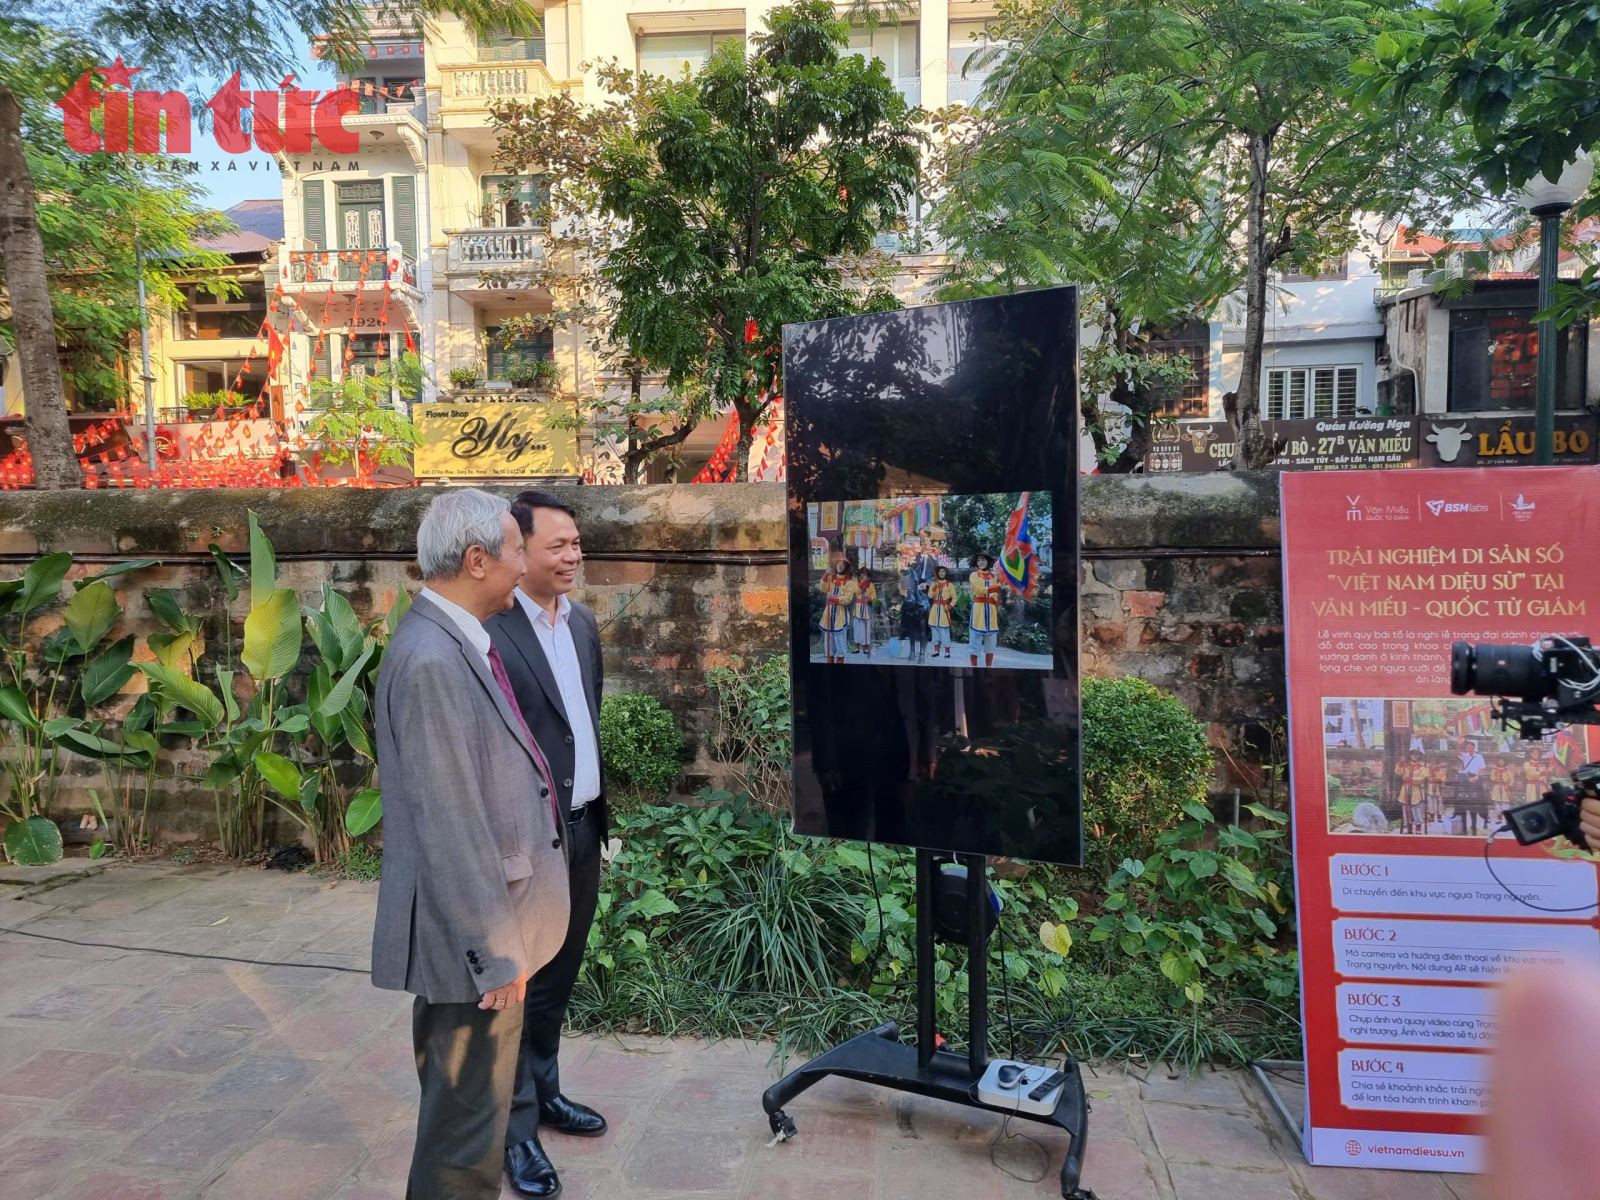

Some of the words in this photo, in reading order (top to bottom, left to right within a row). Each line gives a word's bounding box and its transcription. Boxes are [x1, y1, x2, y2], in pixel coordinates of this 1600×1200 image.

[426, 410, 449, 419] Flower
[450, 410, 469, 420] Shop
[1316, 421, 1346, 432] Quán
[1386, 419, 1411, 431] Nga
[1210, 443, 1236, 458] CHU
[1291, 436, 1309, 456] BÒ
[1347, 434, 1377, 454] VĂN
[1379, 430, 1412, 453] MIẾU
[1478, 419, 1537, 456] LẨU
[1326, 545, 1372, 568] TRẢI
[1378, 545, 1457, 567] NGHIỆM
[1462, 549, 1483, 564] DI
[1489, 543, 1531, 564] SẢN
[1535, 542, 1565, 564] SỐ
[1387, 575, 1435, 591] NAM
[1441, 572, 1487, 593] DIỆU
[1531, 573, 1565, 592] TẠI
[1311, 598, 1354, 617] VĂN
[1360, 596, 1407, 617] MIẾU
[1426, 595, 1490, 619] QUỐC
[1527, 596, 1587, 617] GIÁM
[1331, 630, 1351, 639] vinh
[1353, 632, 1371, 641] quy
[1374, 630, 1390, 639] bái
[1417, 630, 1439, 641] nghi
[1453, 631, 1480, 642] trọng
[1482, 630, 1499, 641] đại
[1501, 630, 1528, 639] dành
[1382, 642, 1409, 652] trong
[1414, 642, 1439, 650] khoa
[1352, 652, 1378, 661] danh
[1390, 652, 1410, 661] kinh
[1343, 664, 1362, 672] che
[1340, 863, 1381, 877] BƯỚC
[1384, 866, 1389, 877] 1
[1342, 886, 1352, 896] Di
[1354, 886, 1388, 898] chuyển
[1389, 888, 1408, 898] đến
[1410, 889, 1428, 898] khu
[1475, 892, 1501, 903] Trạng
[1344, 928, 1385, 941] BƯỚC
[1388, 930, 1397, 942] 2
[1361, 950, 1396, 960] camera
[1398, 951, 1409, 960] và
[1441, 952, 1463, 962] điện
[1464, 953, 1488, 964] thoại
[1346, 960, 1371, 971] Trạng
[1411, 962, 1426, 974] Nội
[1428, 963, 1453, 974] dung
[1454, 965, 1467, 974] AR
[1347, 992, 1389, 1007] BƯỚC
[1391, 995, 1401, 1008] 3
[1349, 1014, 1373, 1026] Chụp
[1373, 1013, 1391, 1024] ảnh
[1391, 1015, 1403, 1025] và
[1404, 1016, 1426, 1028] quay
[1427, 1016, 1451, 1027] video
[1452, 1016, 1474, 1029] cùng
[1418, 1027, 1430, 1037] và
[1431, 1028, 1455, 1039] video
[1351, 1058, 1393, 1073] BƯỚC
[1395, 1061, 1404, 1074] 4
[1351, 1080, 1373, 1090] Chia
[1388, 1082, 1423, 1093] khoảnh
[1366, 1093, 1381, 1103] lan
[1402, 1094, 1427, 1105] hành
[1428, 1095, 1450, 1106] trình
[1367, 1144, 1465, 1158] vietnamdieusu.vn
